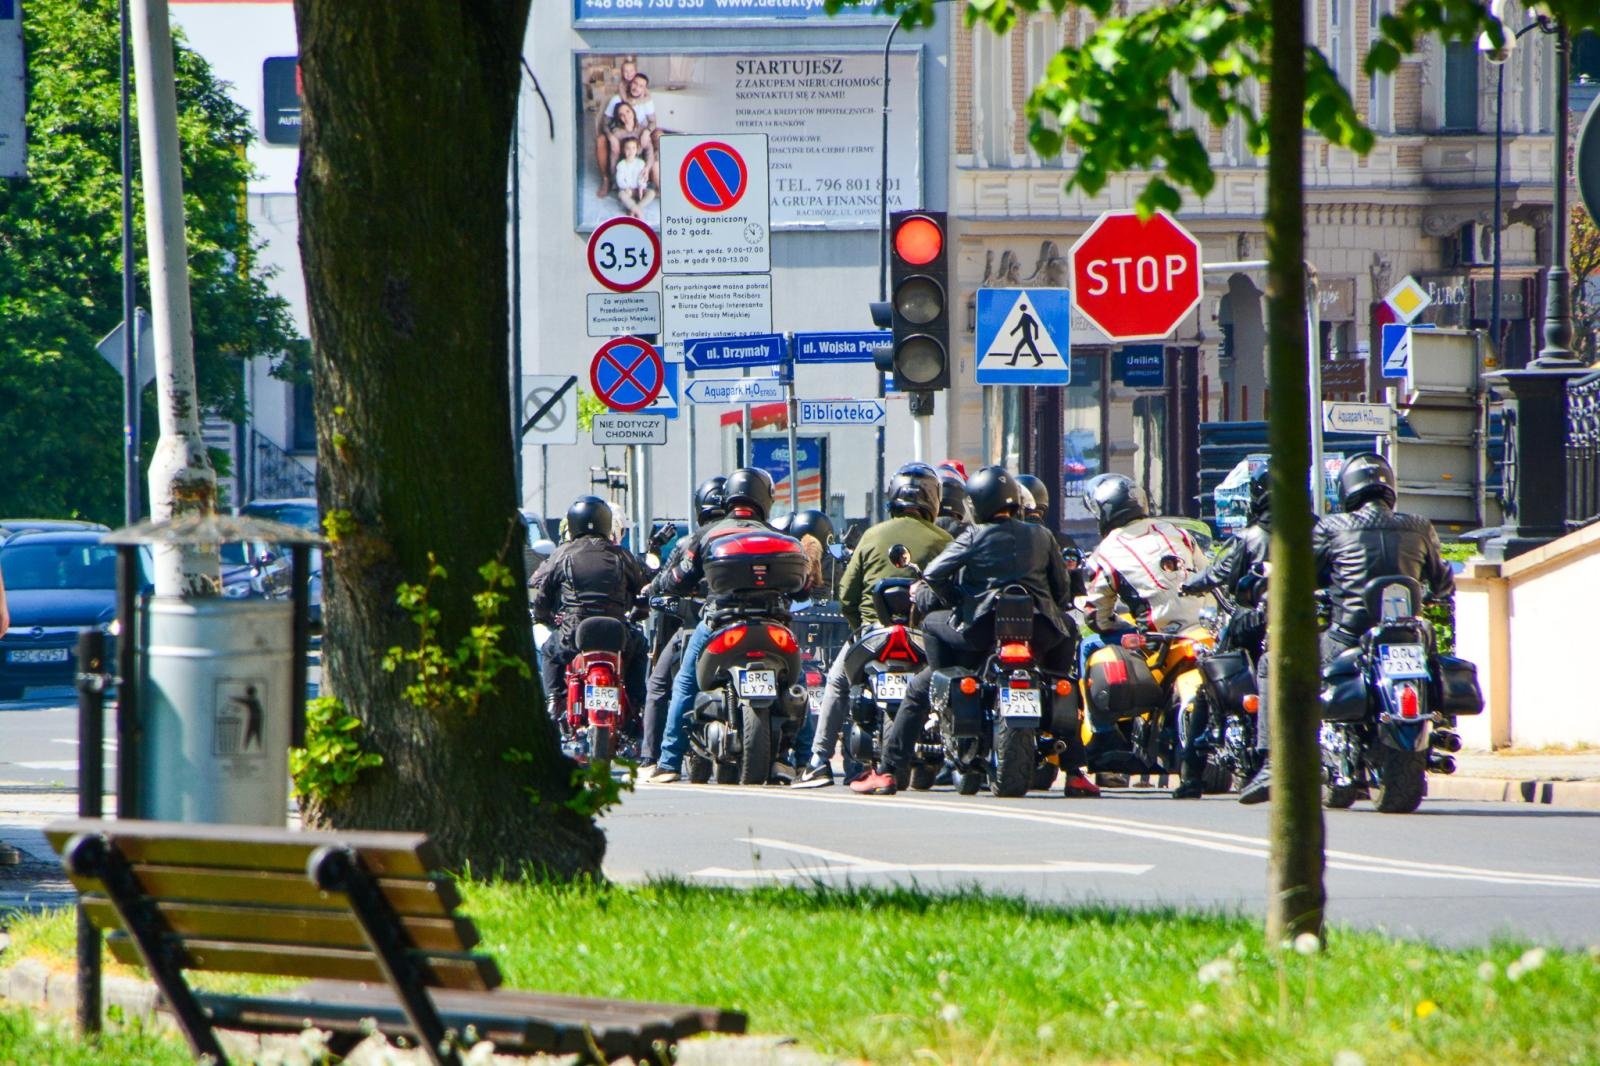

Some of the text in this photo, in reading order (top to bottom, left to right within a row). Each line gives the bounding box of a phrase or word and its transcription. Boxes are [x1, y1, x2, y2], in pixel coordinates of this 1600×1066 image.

[735, 58, 844, 76] STARTUJESZ
[735, 79, 742, 88] Z
[745, 78, 795, 88] ZAKUPEM
[735, 90, 846, 101] SKONTAKTUJ SIĘ Z NAMI!
[735, 108, 772, 116] DORADCA
[774, 107, 815, 116] KREDYTÓW
[773, 119, 805, 127] BANKÓW
[771, 135, 821, 143] GOTÓWKOWE
[776, 178, 811, 192] TEL.
[816, 178, 842, 192] 796
[846, 178, 870, 192] 801
[782, 196, 823, 207] GRUPA
[666, 216, 748, 225] Postój ograniczony
[667, 228, 677, 236] do
[689, 228, 713, 237] godz.
[600, 242, 648, 271] 3,5t
[1086, 254, 1187, 297] STOP
[706, 344, 770, 360] ul. Drzymały
[803, 342, 817, 354] ul.
[819, 341, 857, 354] Wojska
[1127, 356, 1160, 365] Unilink
[704, 385, 744, 398] Aquapark
[803, 404, 874, 420] Biblioteka
[748, 672, 768, 682] SRC
[887, 675, 908, 684] PGN
[594, 688, 614, 697] SRC
[743, 685, 773, 693] LX79
[880, 687, 906, 696] 03T
[1011, 691, 1034, 701] SRC
[1005, 704, 1038, 713] 72LX
